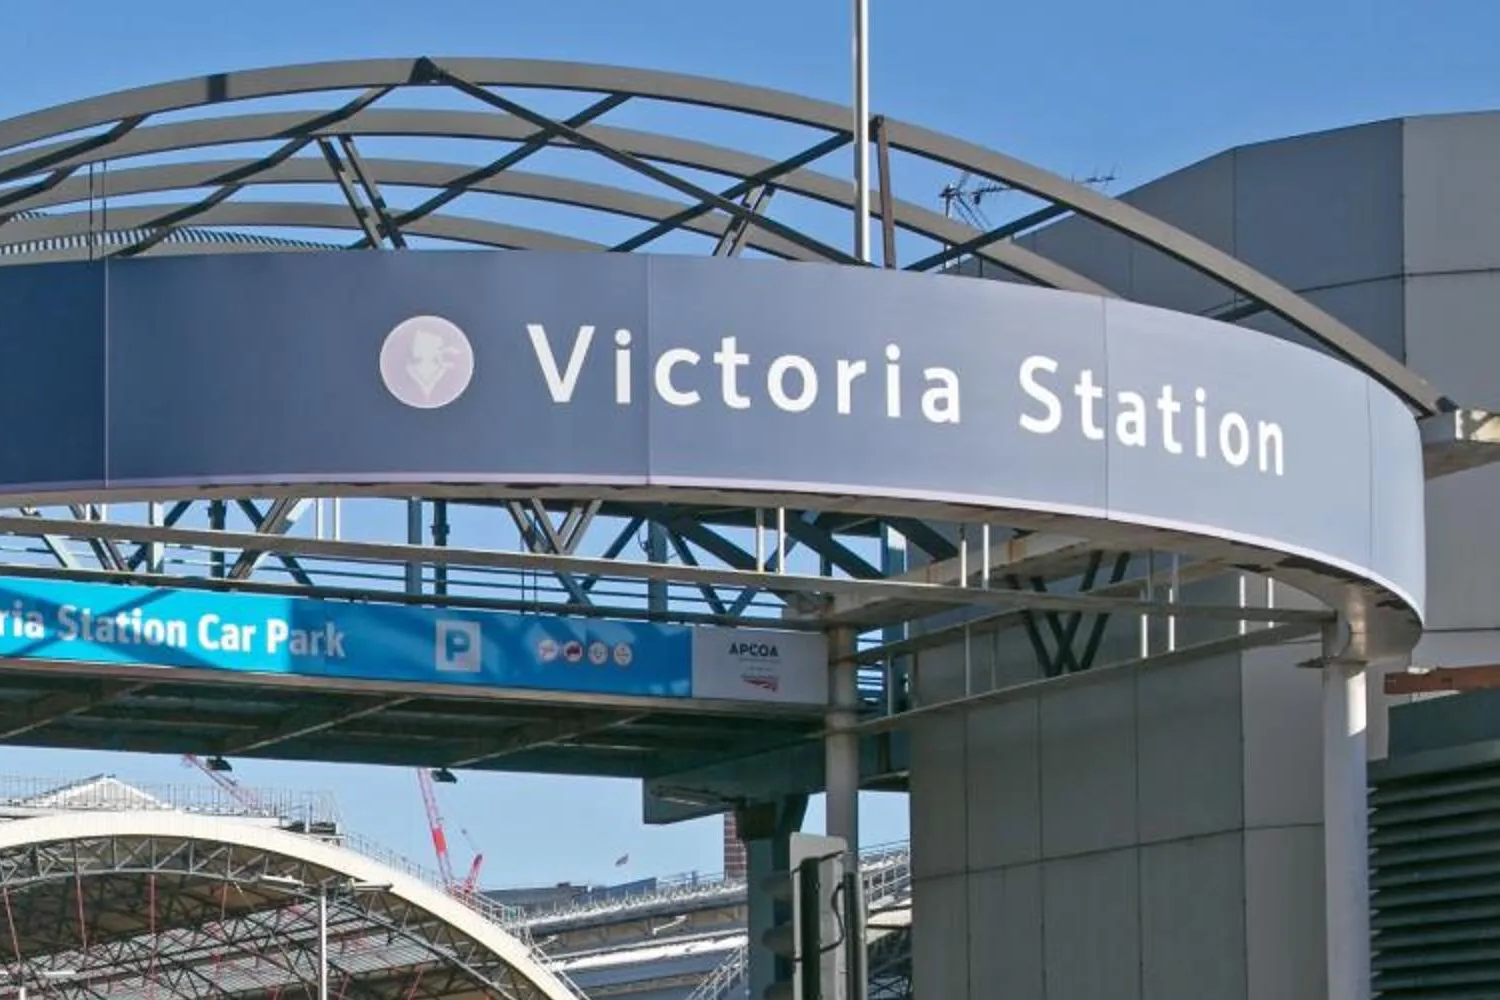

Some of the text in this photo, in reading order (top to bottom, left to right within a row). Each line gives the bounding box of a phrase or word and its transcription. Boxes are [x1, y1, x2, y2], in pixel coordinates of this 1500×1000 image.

[526, 324, 1285, 477] Victoria Station
[58, 604, 188, 649] Station
[198, 613, 257, 653] Car
[266, 618, 346, 659] Park
[445, 629, 471, 663] P
[729, 642, 779, 657] APCOA
